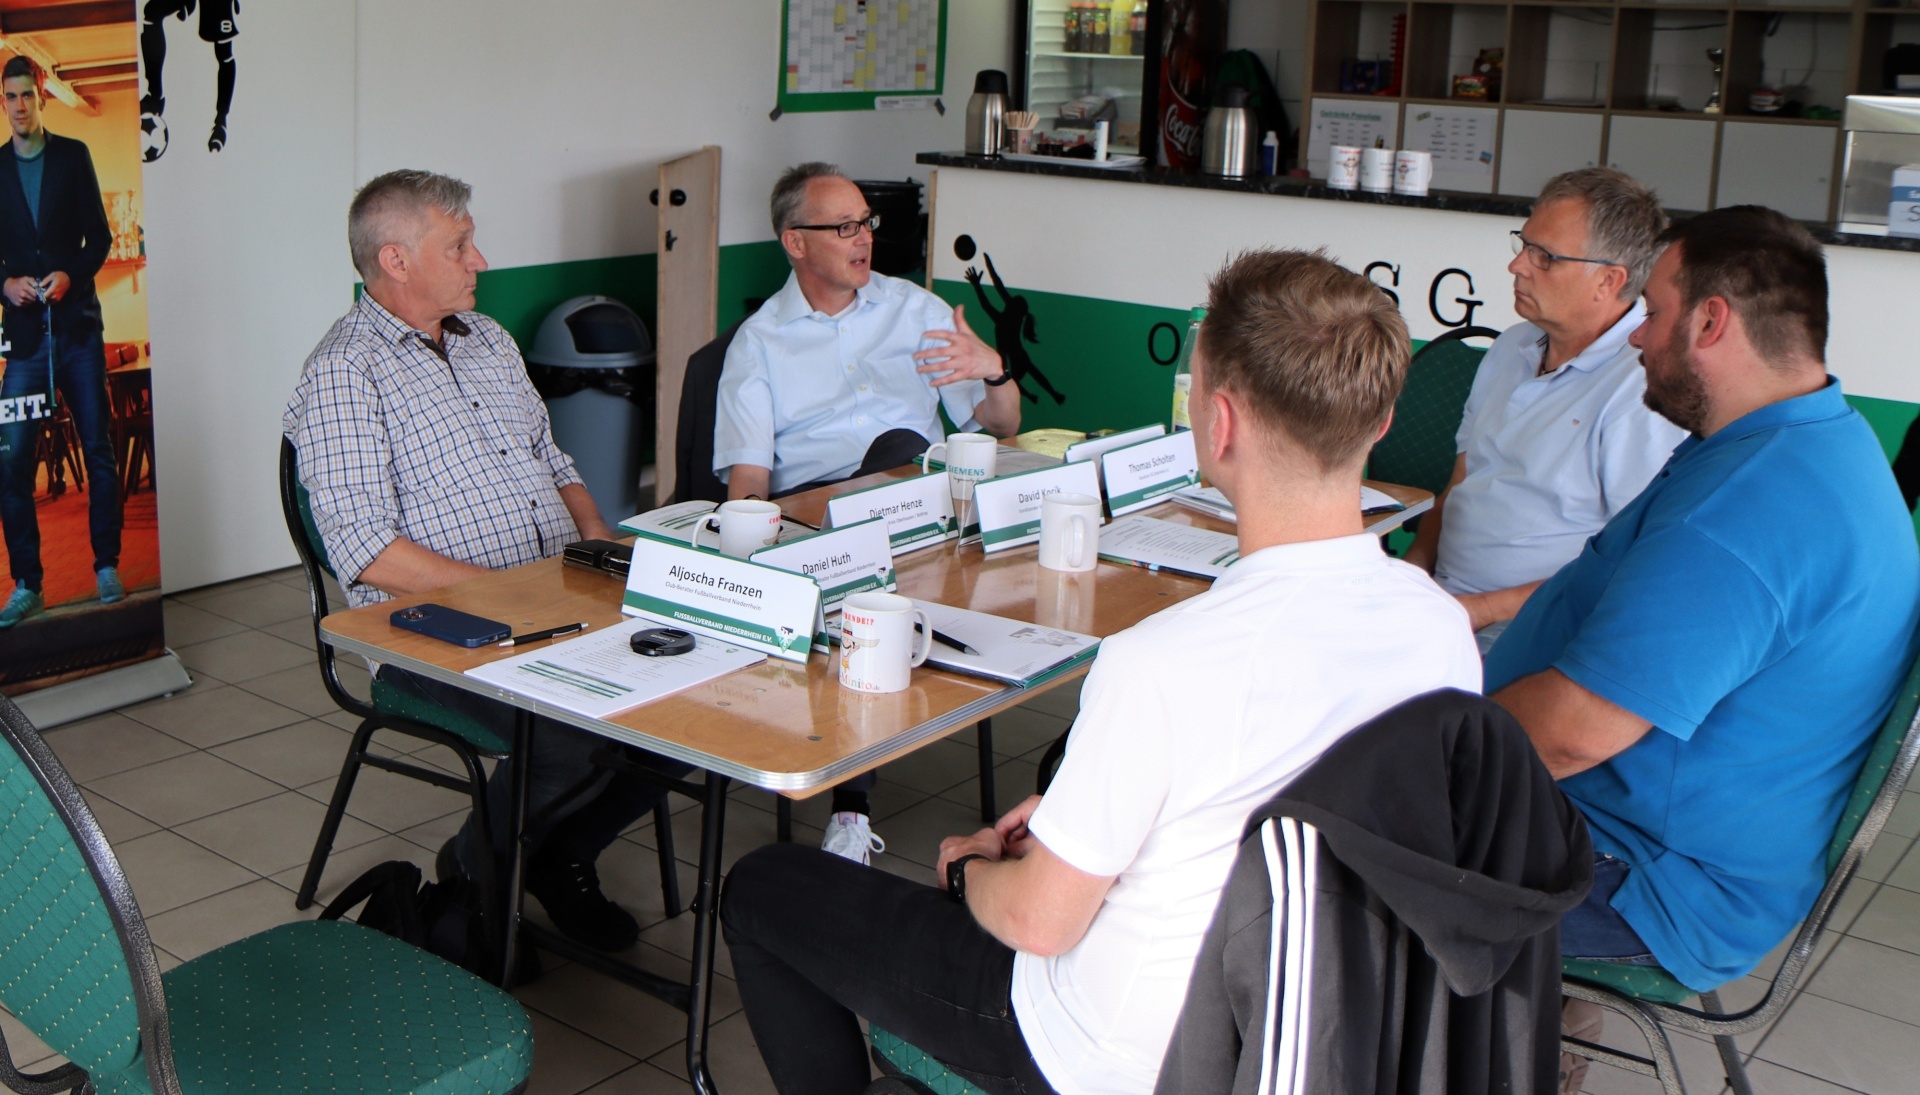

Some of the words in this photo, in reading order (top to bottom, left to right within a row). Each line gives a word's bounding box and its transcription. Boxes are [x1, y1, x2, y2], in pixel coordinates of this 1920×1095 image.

[220, 20, 233, 33] 8
[947, 465, 985, 476] SIEMENS
[1128, 461, 1152, 474] Thomas
[1018, 489, 1040, 504] David
[869, 503, 899, 519] Dietmar
[900, 499, 923, 512] Henze
[802, 556, 830, 575] Daniel
[830, 551, 852, 568] Huth
[668, 565, 715, 587] Aljoscha
[717, 577, 763, 599] Franzen
[673, 611, 723, 630] FUSSBALLVERBAND
[723, 624, 762, 640] NIEDERRHEIN
